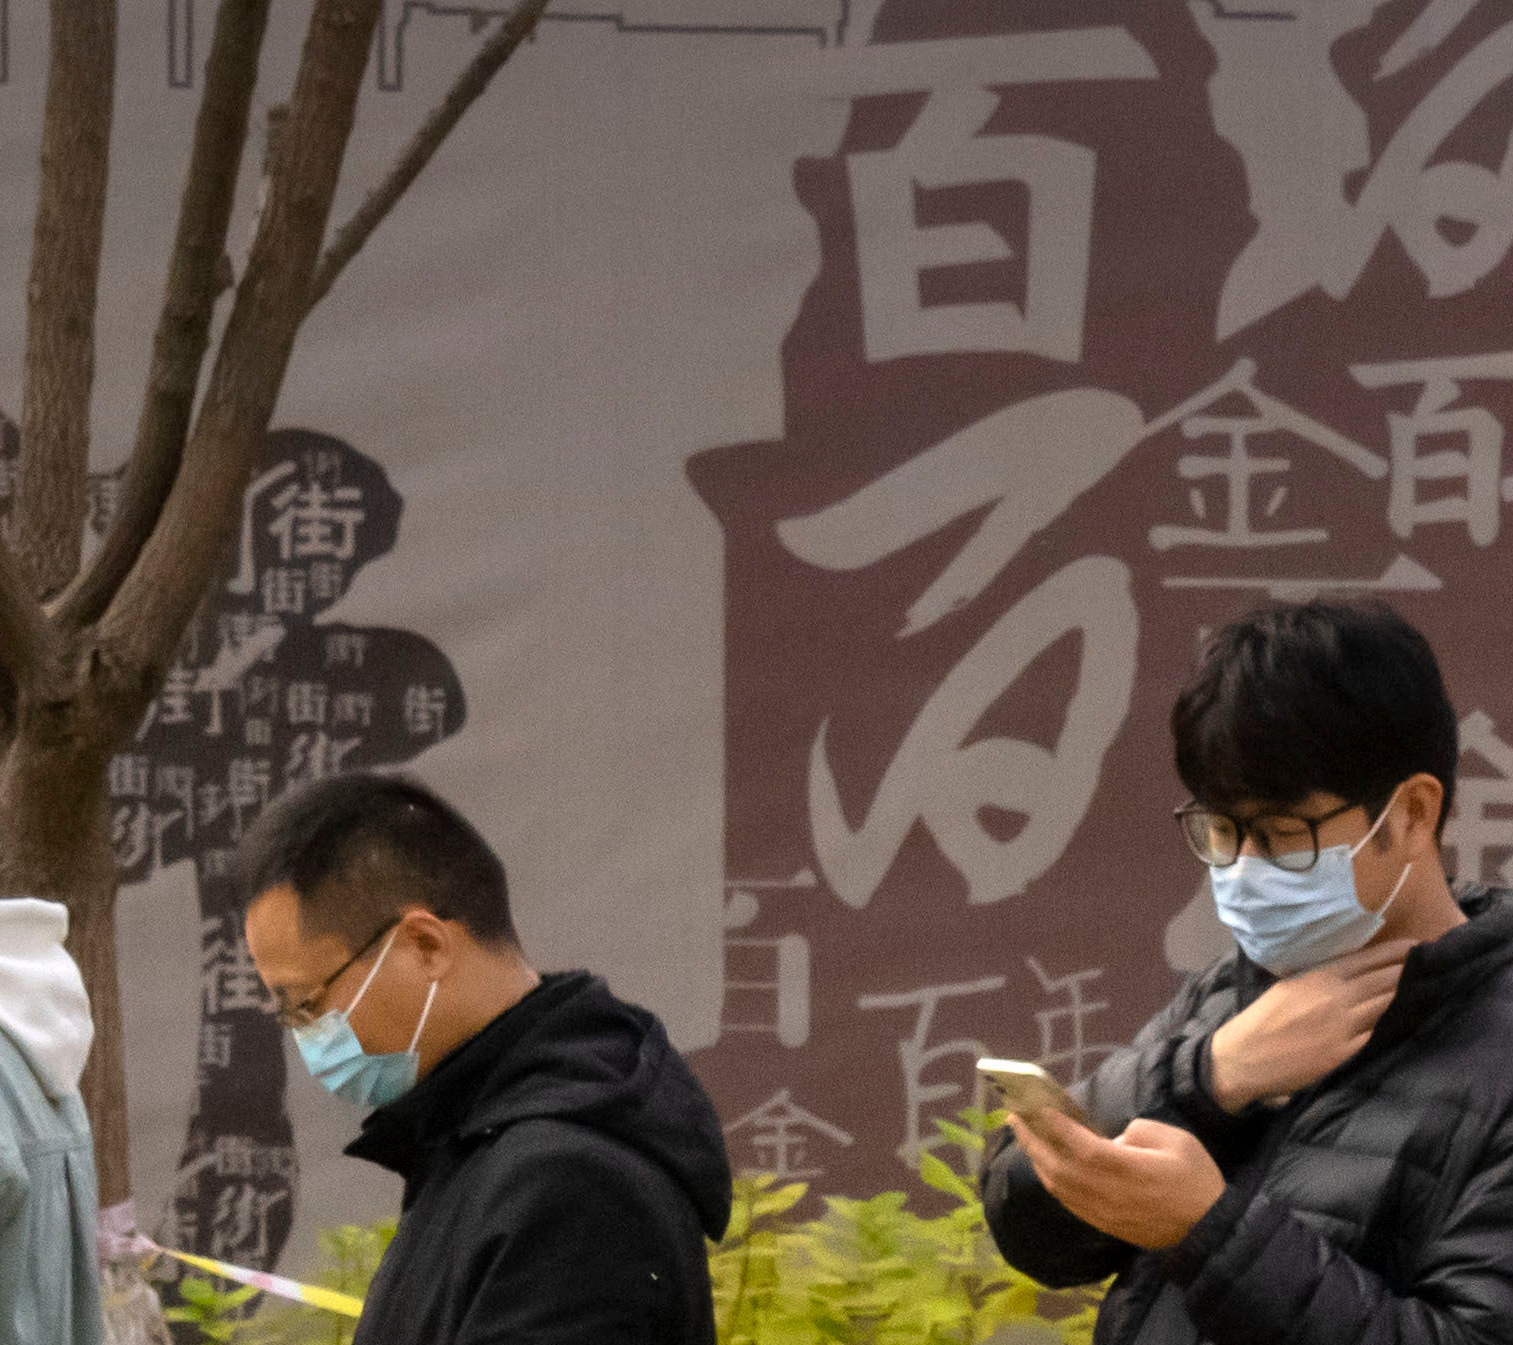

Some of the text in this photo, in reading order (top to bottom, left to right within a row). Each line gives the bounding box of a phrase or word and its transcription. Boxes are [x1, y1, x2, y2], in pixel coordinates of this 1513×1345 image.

[822, 24, 1161, 364] 百
[268, 482, 366, 561] 街
[1140, 358, 1390, 550] 金
